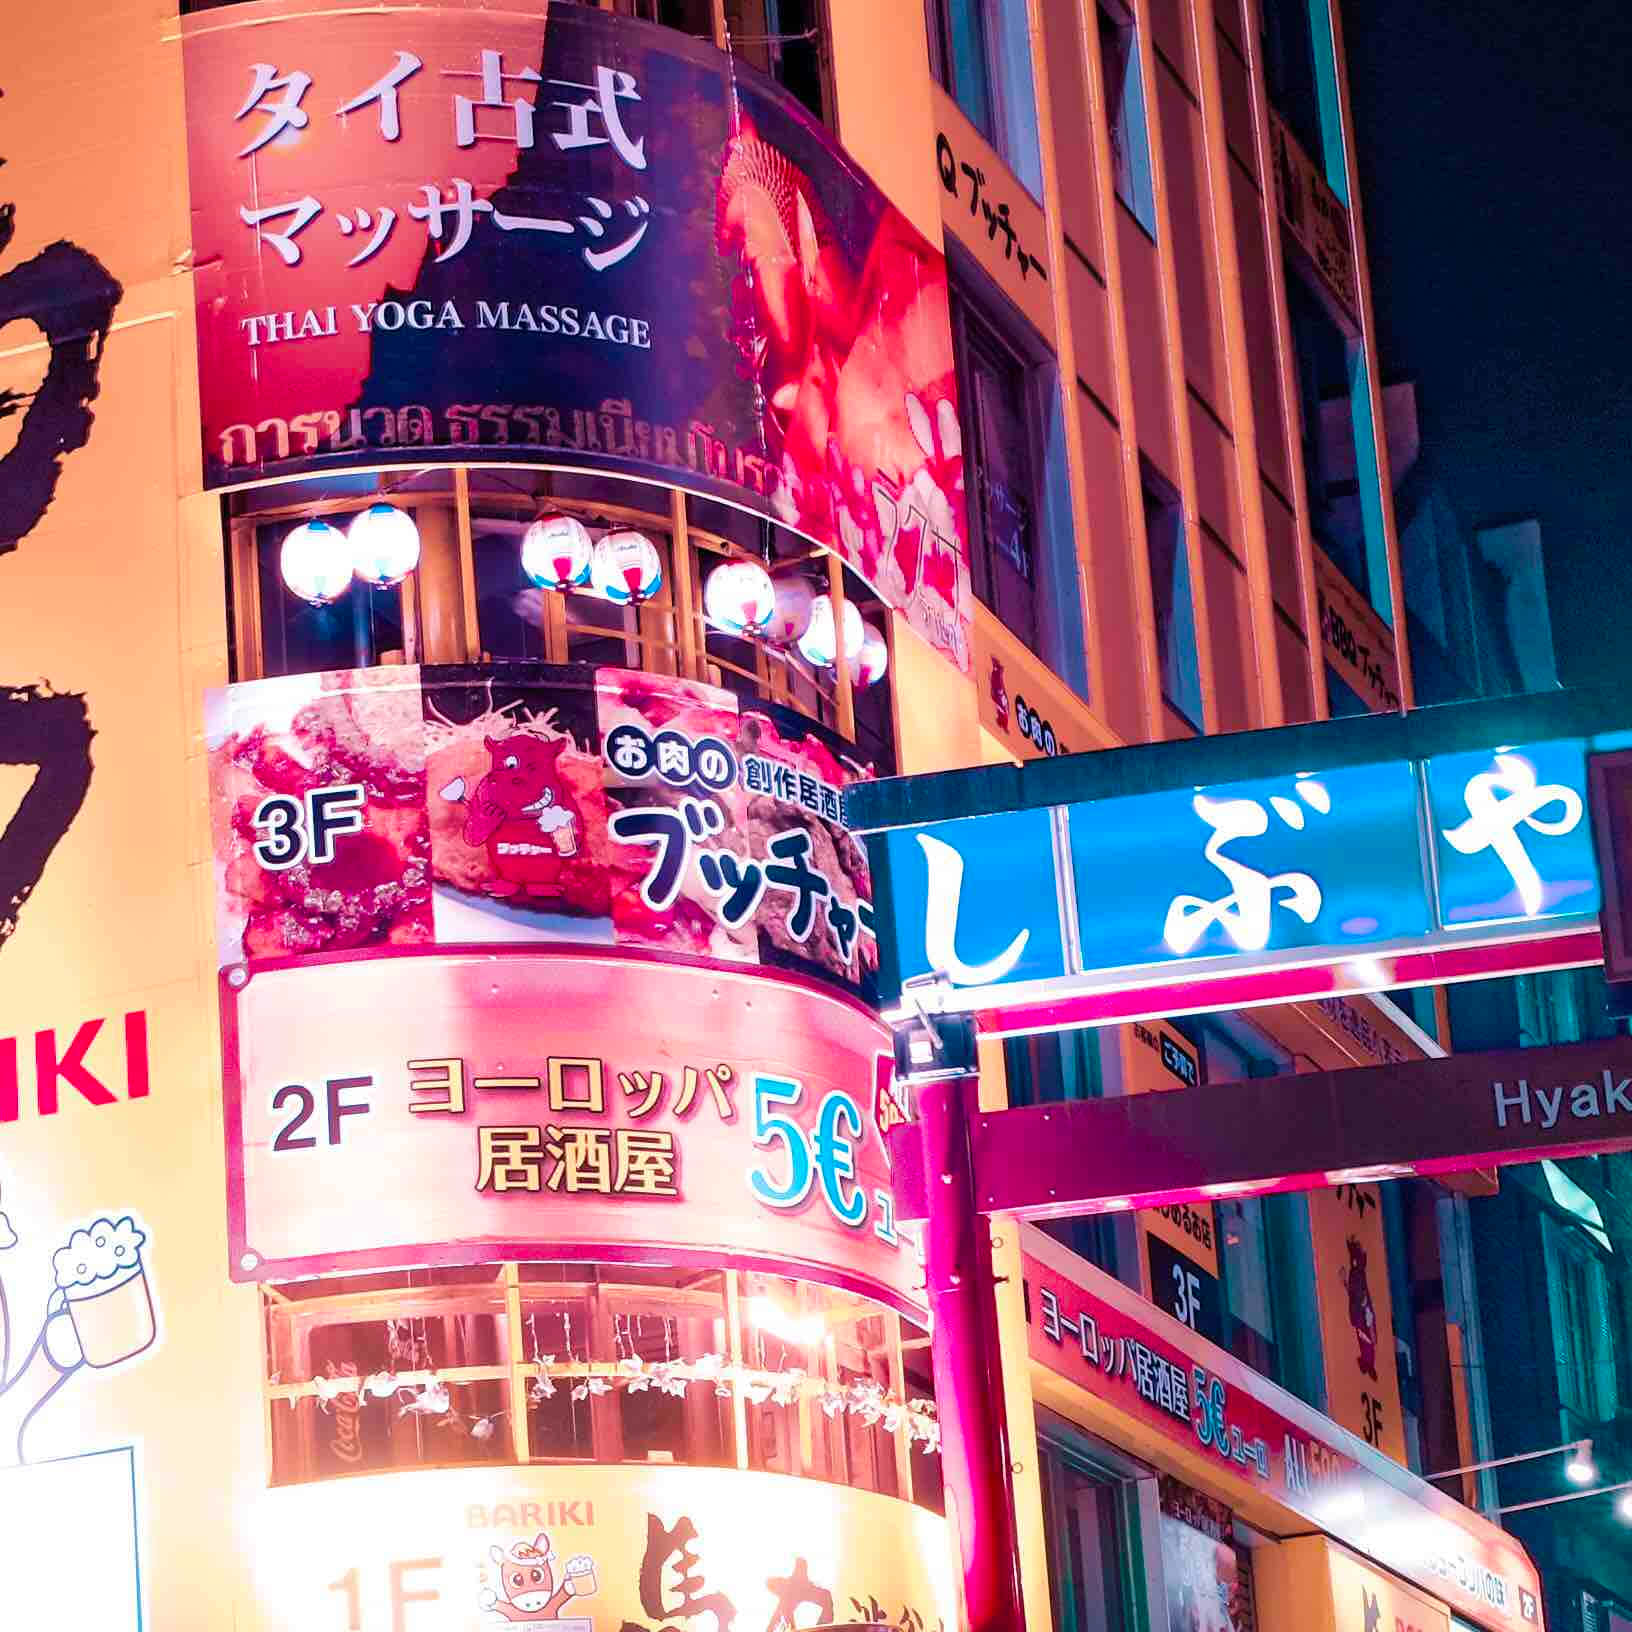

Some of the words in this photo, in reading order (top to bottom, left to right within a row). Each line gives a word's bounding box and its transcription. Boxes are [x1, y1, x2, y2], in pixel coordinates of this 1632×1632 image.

[235, 49, 650, 171] タイ古式
[238, 176, 653, 272] マッサージ
[242, 309, 337, 347] THAI
[349, 299, 462, 334] YOGA
[476, 301, 653, 350] MASSAGE
[611, 729, 731, 786] お肉の
[254, 788, 364, 869] 3F
[272, 1078, 373, 1152] 2F
[407, 1056, 736, 1121] ヨーロッパ
[475, 1125, 679, 1198] 居酒屋
[749, 1074, 867, 1228] 5€
[1172, 1262, 1201, 1331] 3F
[1040, 1286, 1191, 1422] ヨーロッパ居酒屋
[464, 1500, 595, 1530] BARIKI
